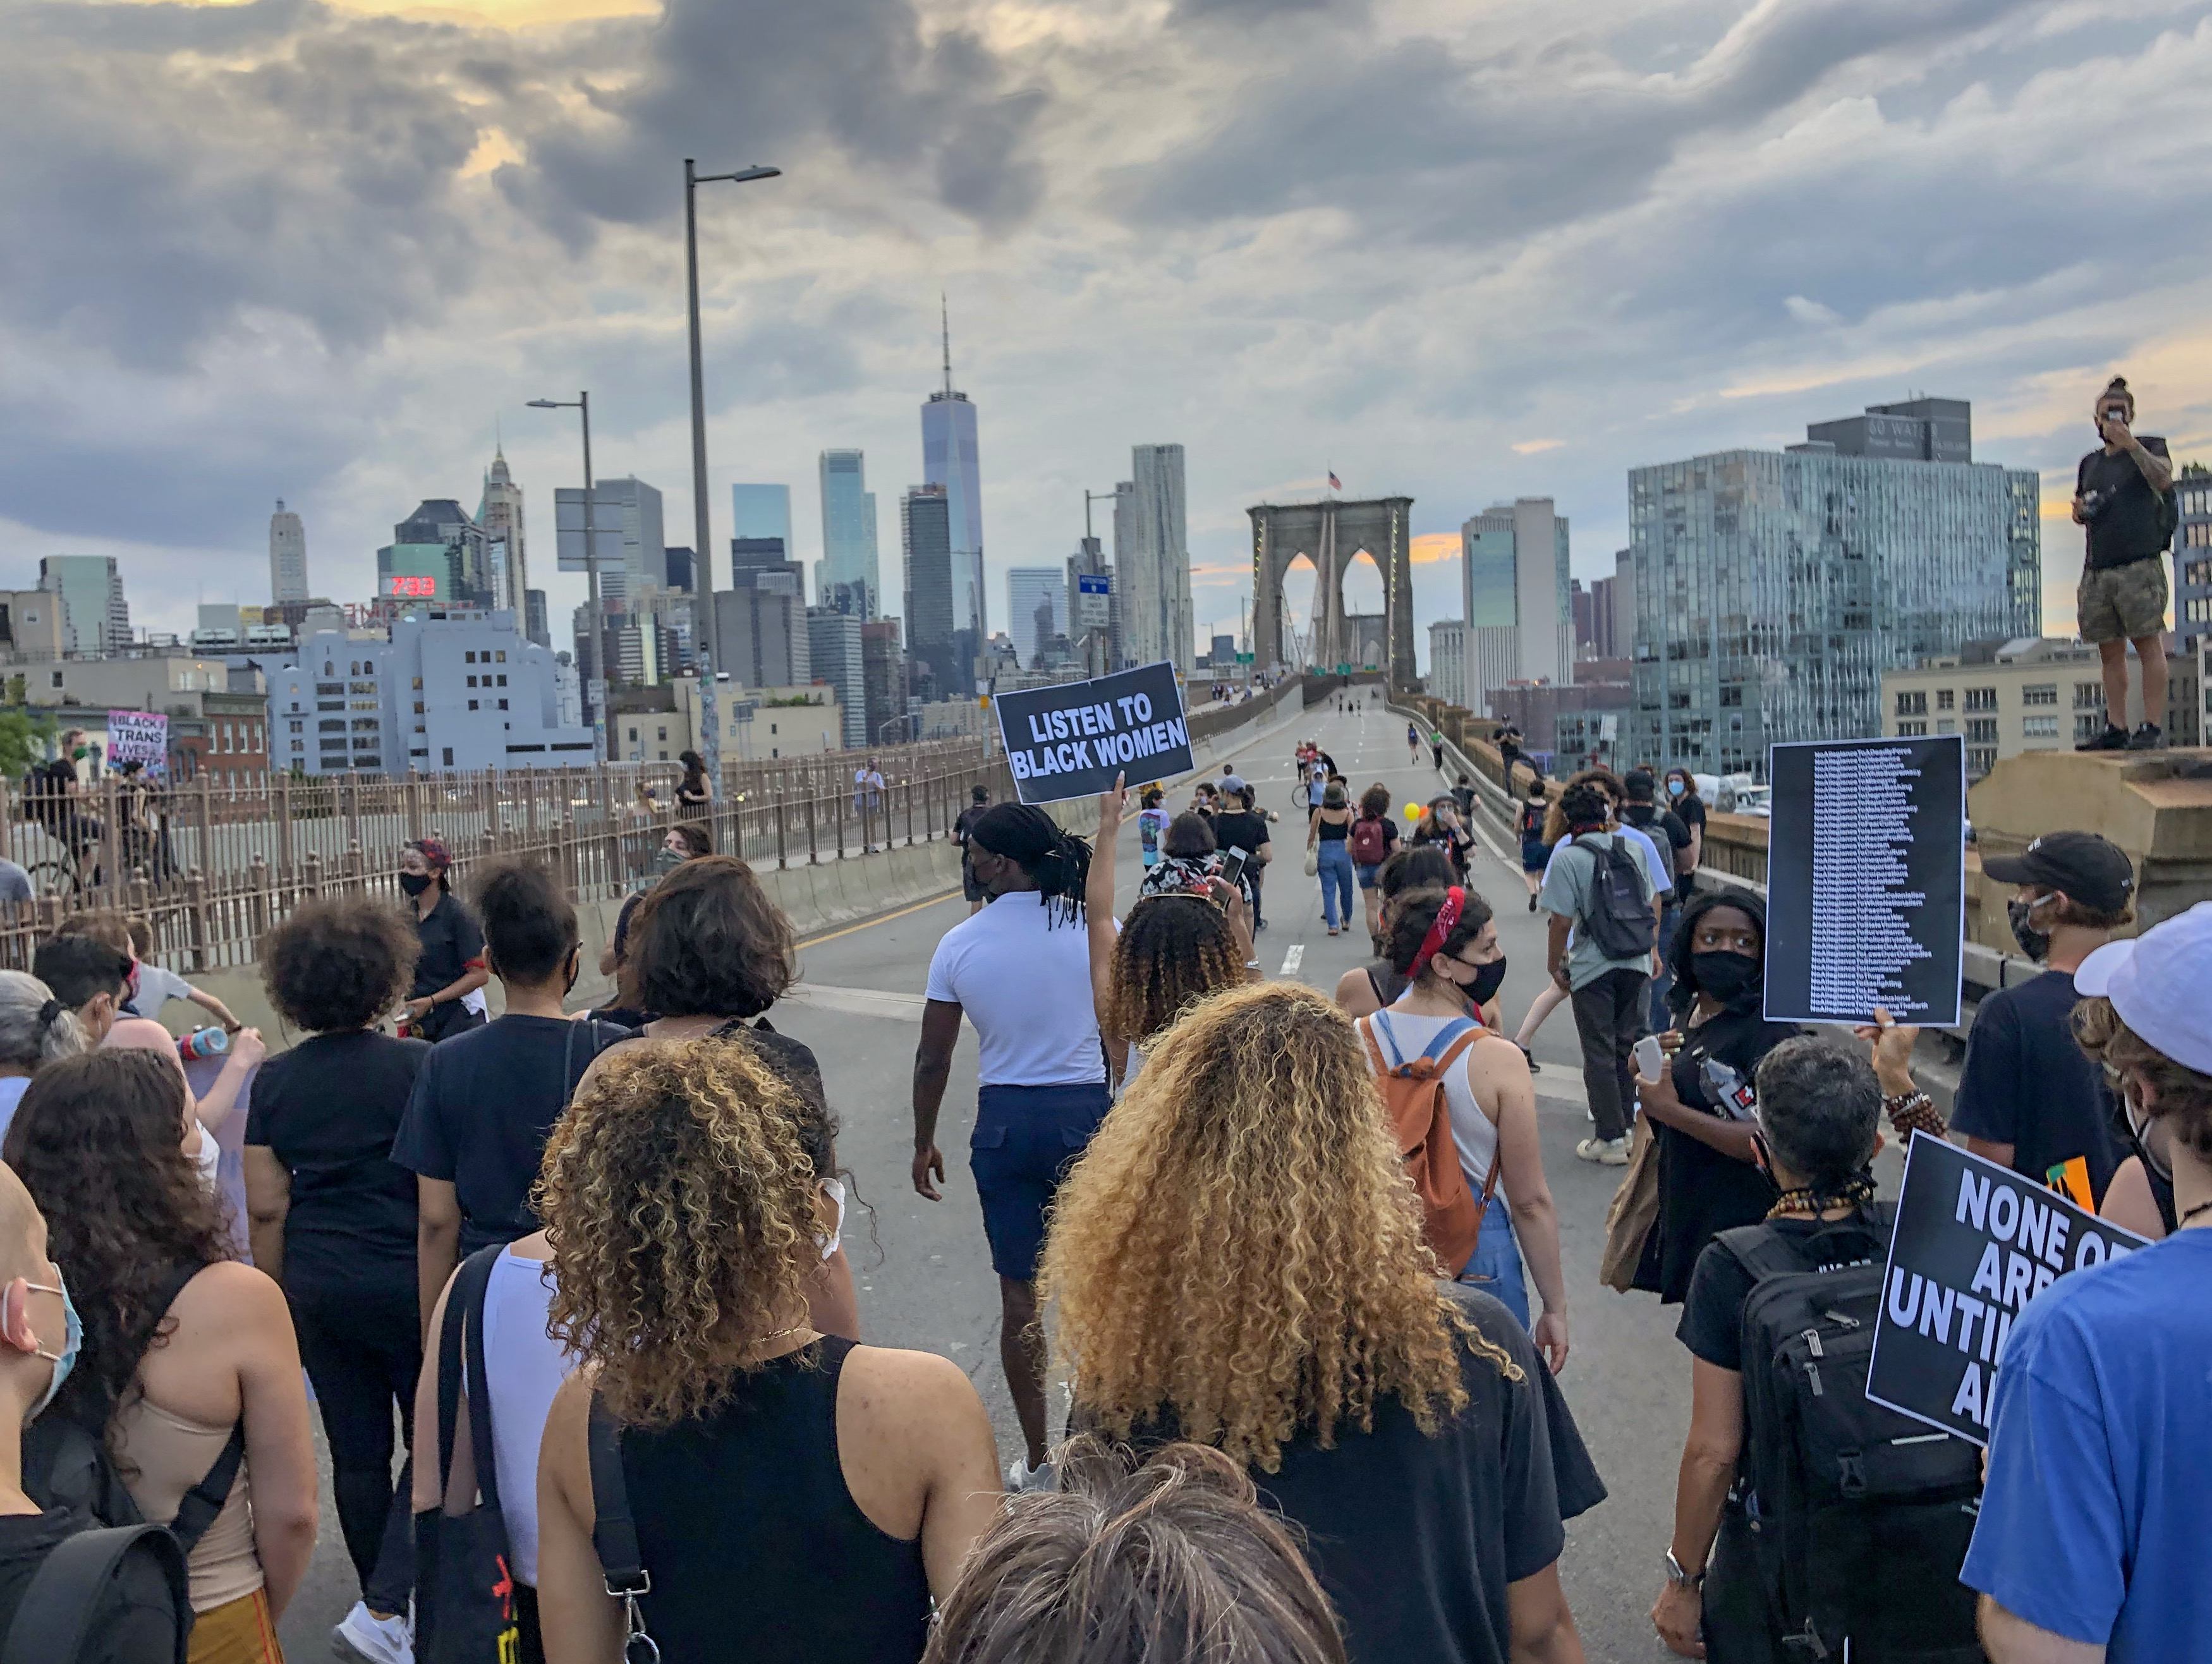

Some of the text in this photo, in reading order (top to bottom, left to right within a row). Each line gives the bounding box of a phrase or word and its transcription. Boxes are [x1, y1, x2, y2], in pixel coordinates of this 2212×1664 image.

[118, 715, 157, 728] BLACK
[1028, 692, 1153, 743] LISTEN TO
[116, 729, 162, 743] TRANS
[116, 744, 149, 755] LIVES
[1010, 717, 1187, 779] BLACK WOMEN
[1955, 1168, 2134, 1272] NONE O
